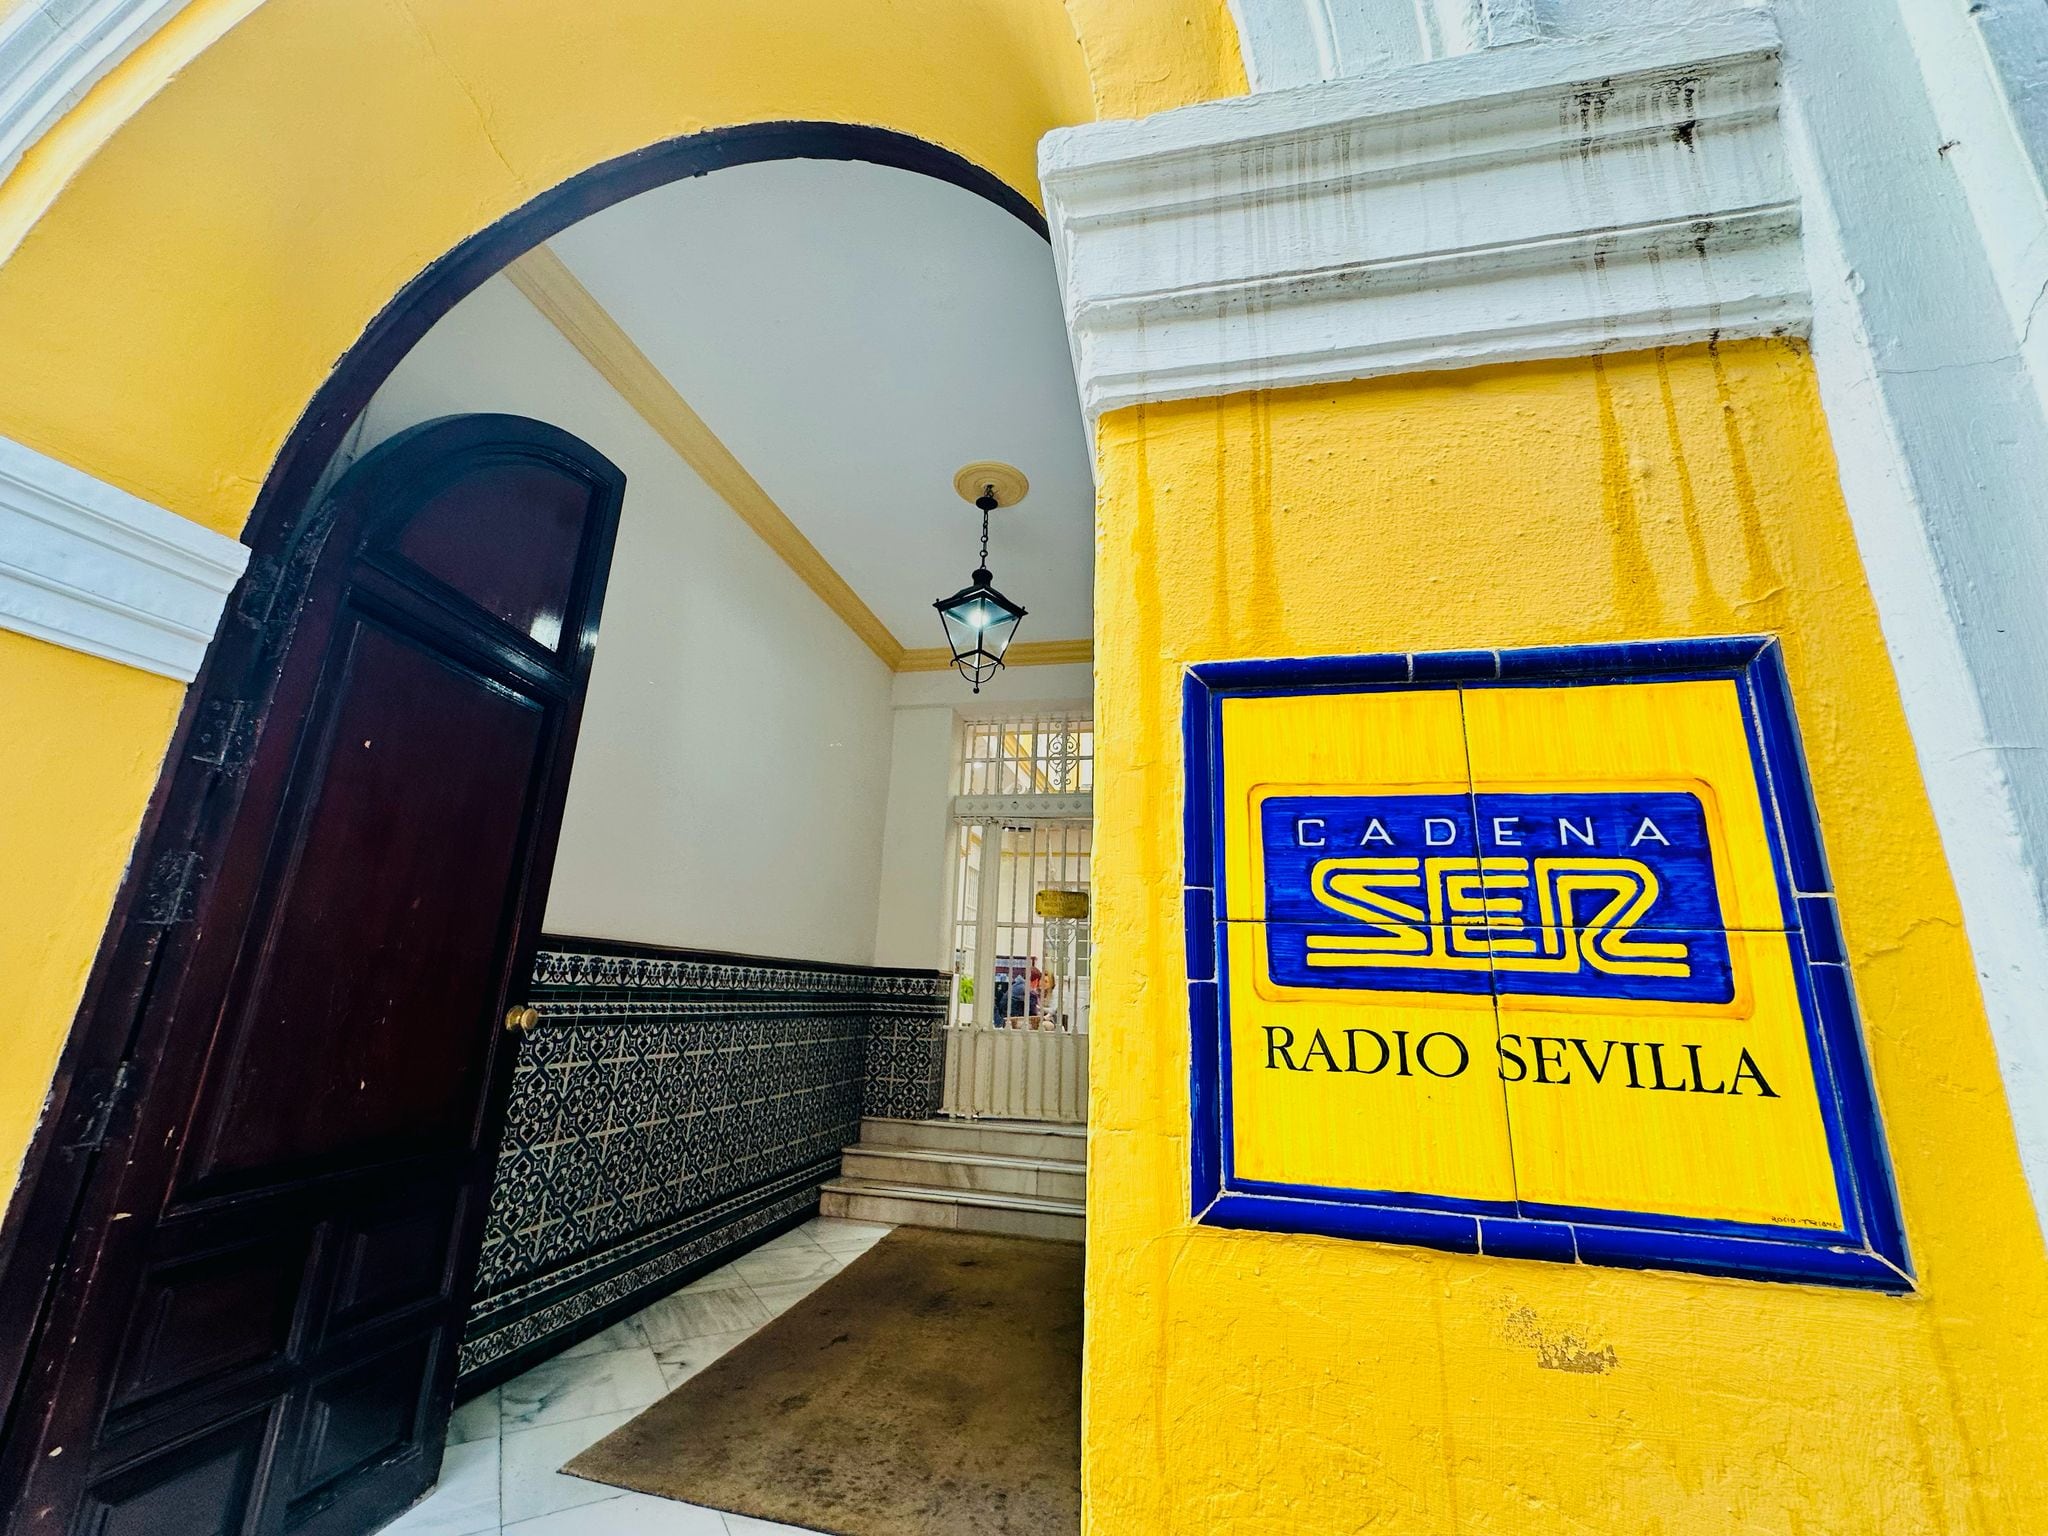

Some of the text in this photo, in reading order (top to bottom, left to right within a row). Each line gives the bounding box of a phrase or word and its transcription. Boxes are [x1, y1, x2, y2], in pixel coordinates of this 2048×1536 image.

[1297, 817, 1671, 847] CADENA
[1306, 857, 1691, 978] SER
[1261, 1025, 1781, 1098] RADIO SEVILLA
